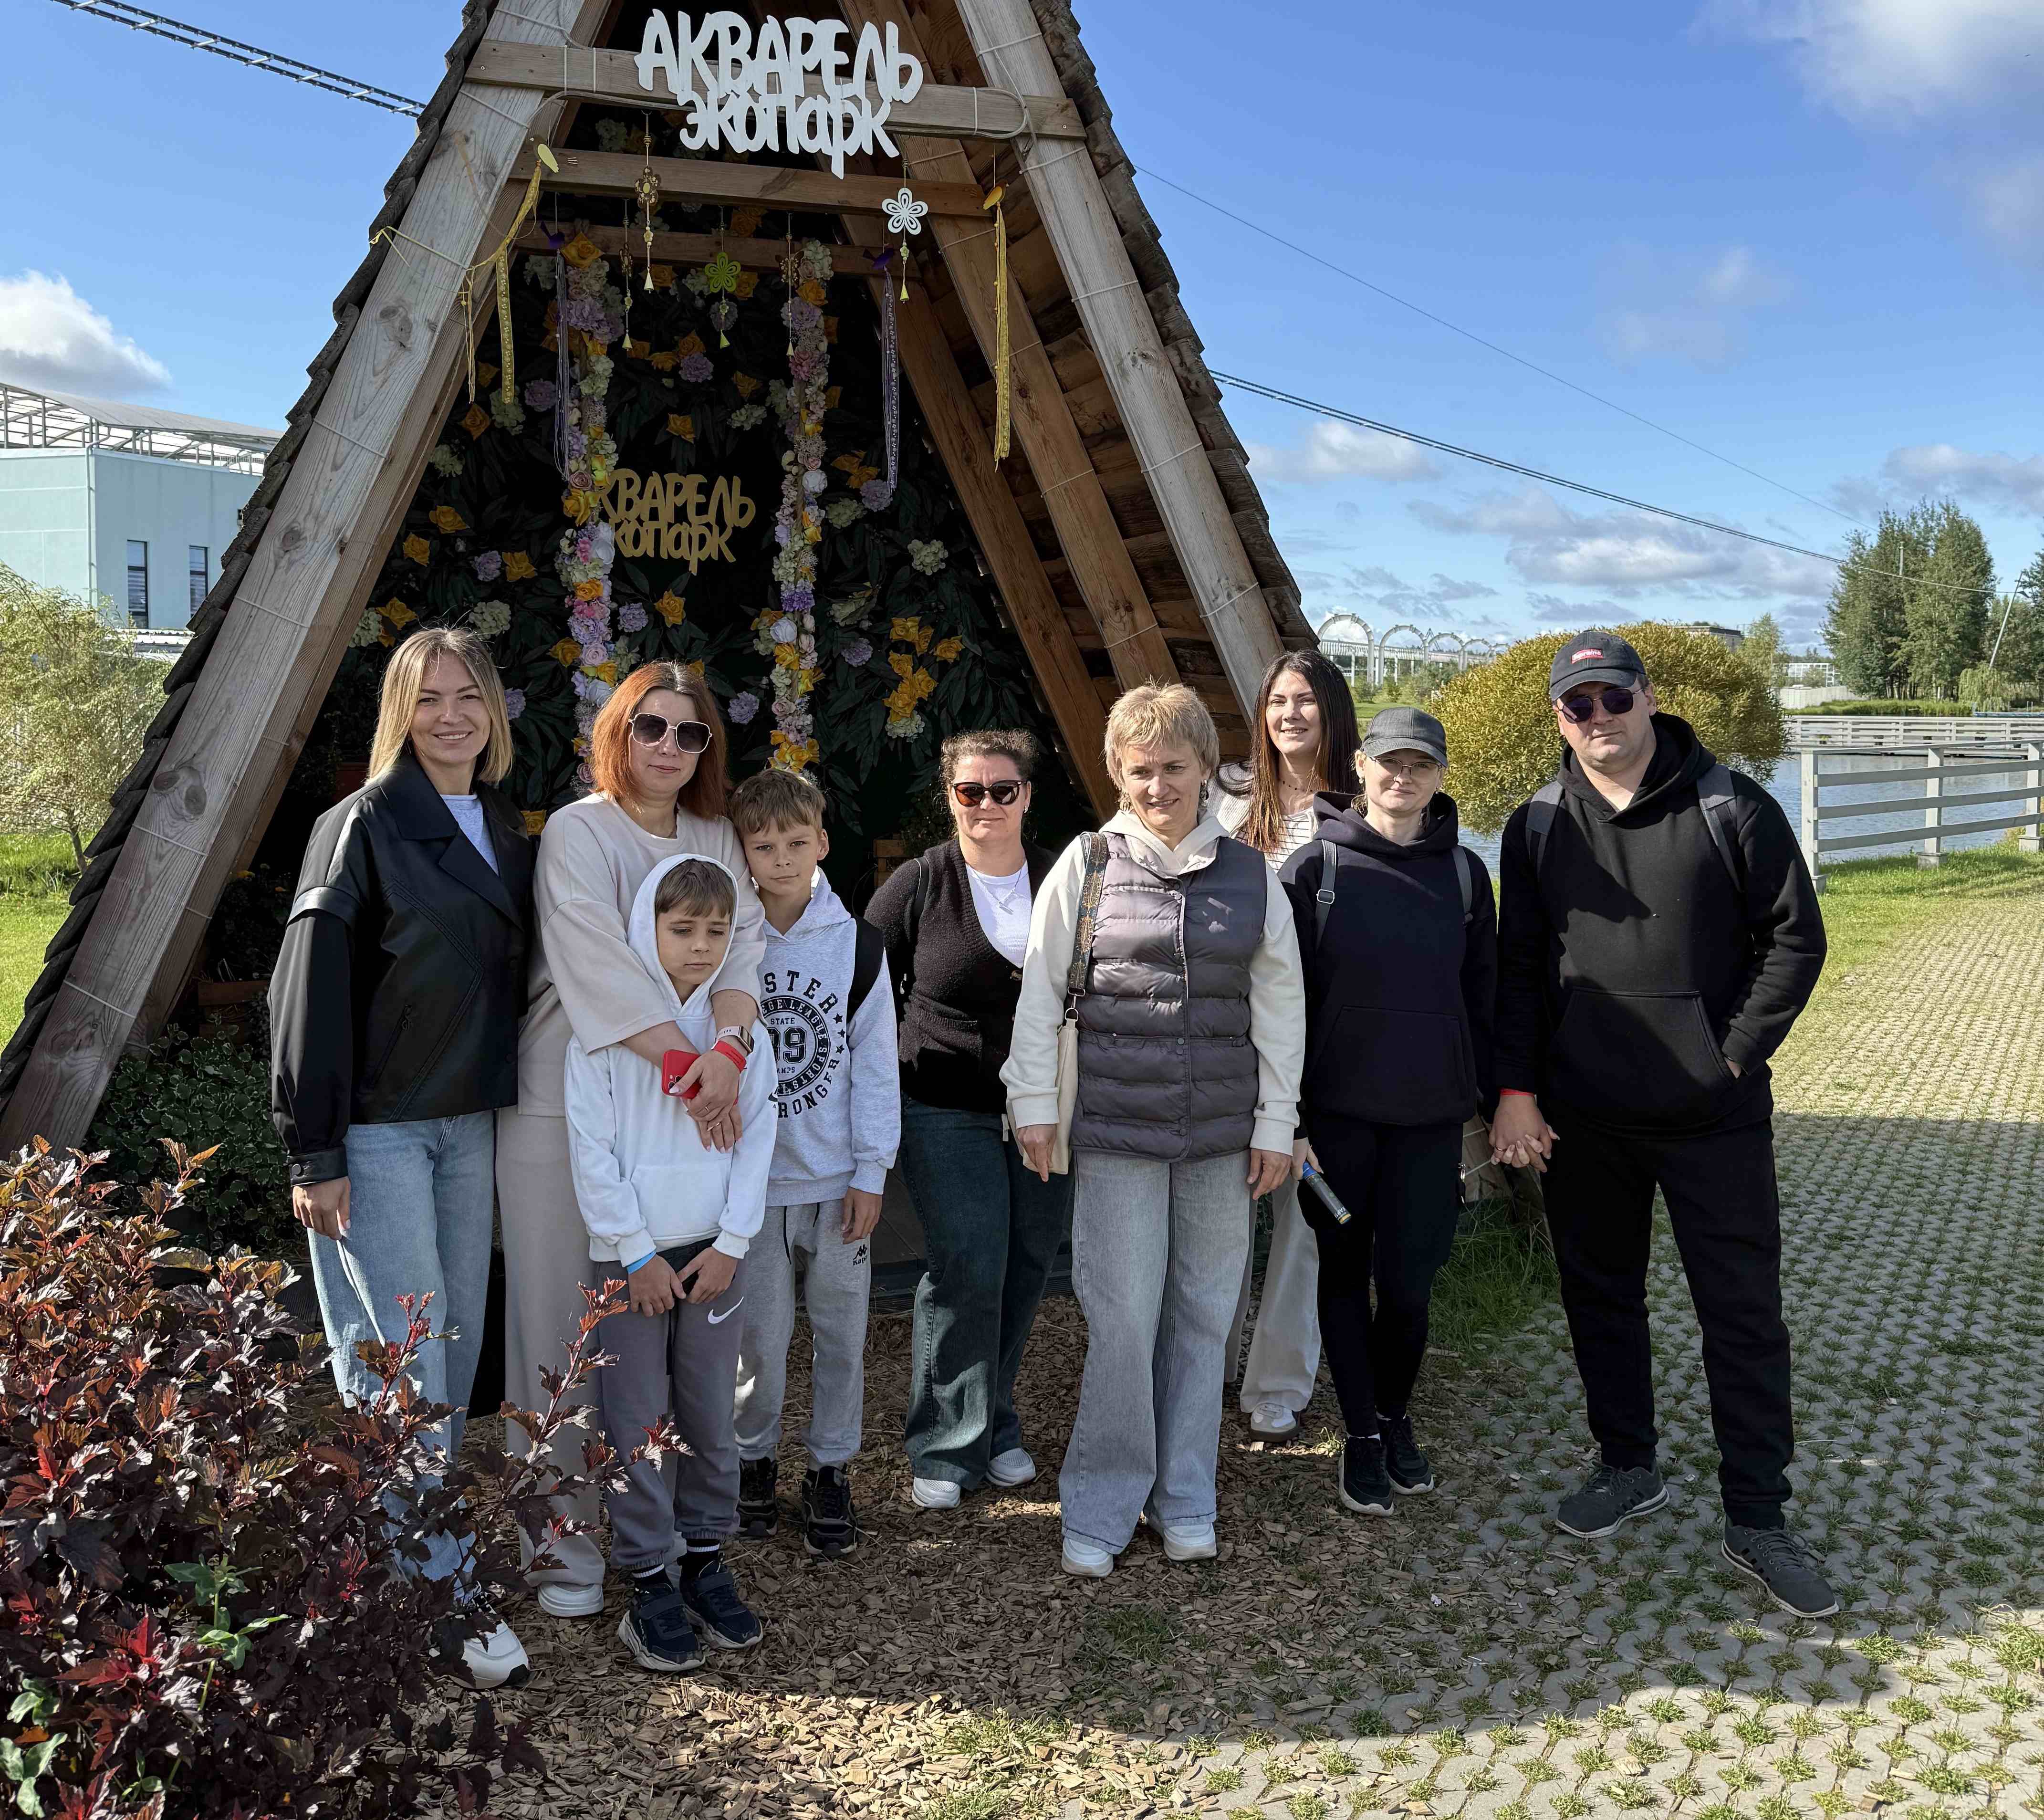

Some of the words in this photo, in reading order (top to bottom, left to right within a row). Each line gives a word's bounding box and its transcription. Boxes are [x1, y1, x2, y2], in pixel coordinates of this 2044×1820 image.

[634, 9, 923, 103] АКВАРЕЛЬ
[594, 468, 756, 528] КВАРЕЛЬ
[761, 999, 783, 1015] EGE
[764, 970, 838, 1014] STER
[790, 1000, 827, 1039] LEAGUE
[778, 1059, 840, 1118] RONGER
[793, 1047, 827, 1089] SPORTS
